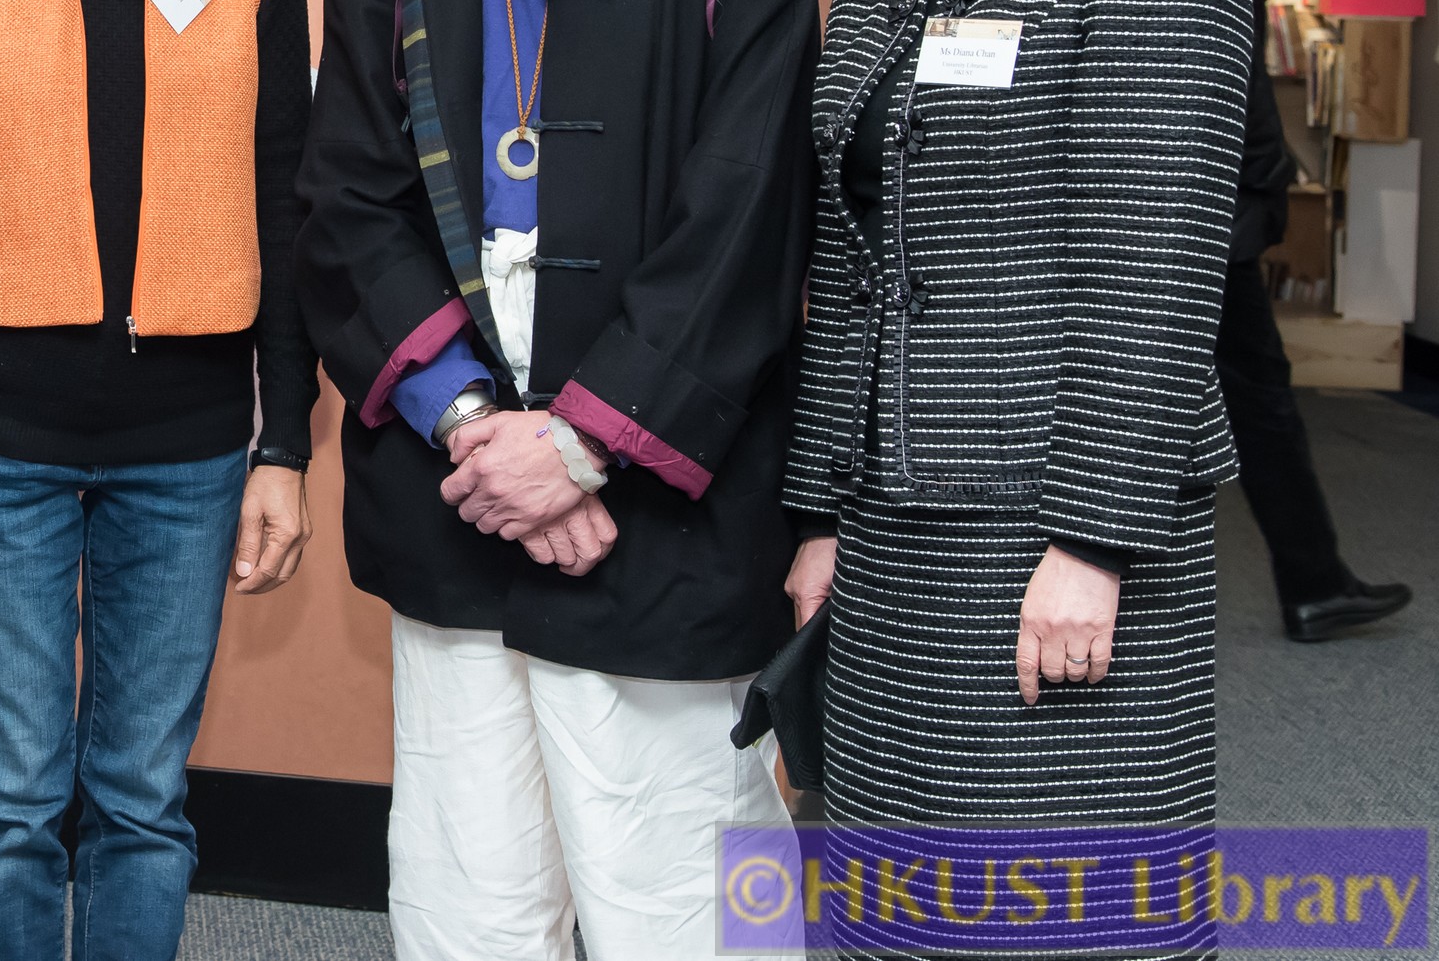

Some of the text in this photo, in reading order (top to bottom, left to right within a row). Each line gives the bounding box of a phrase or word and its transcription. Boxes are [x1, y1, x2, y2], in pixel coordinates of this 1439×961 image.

[940, 47, 996, 58] Ms Diana Chan
